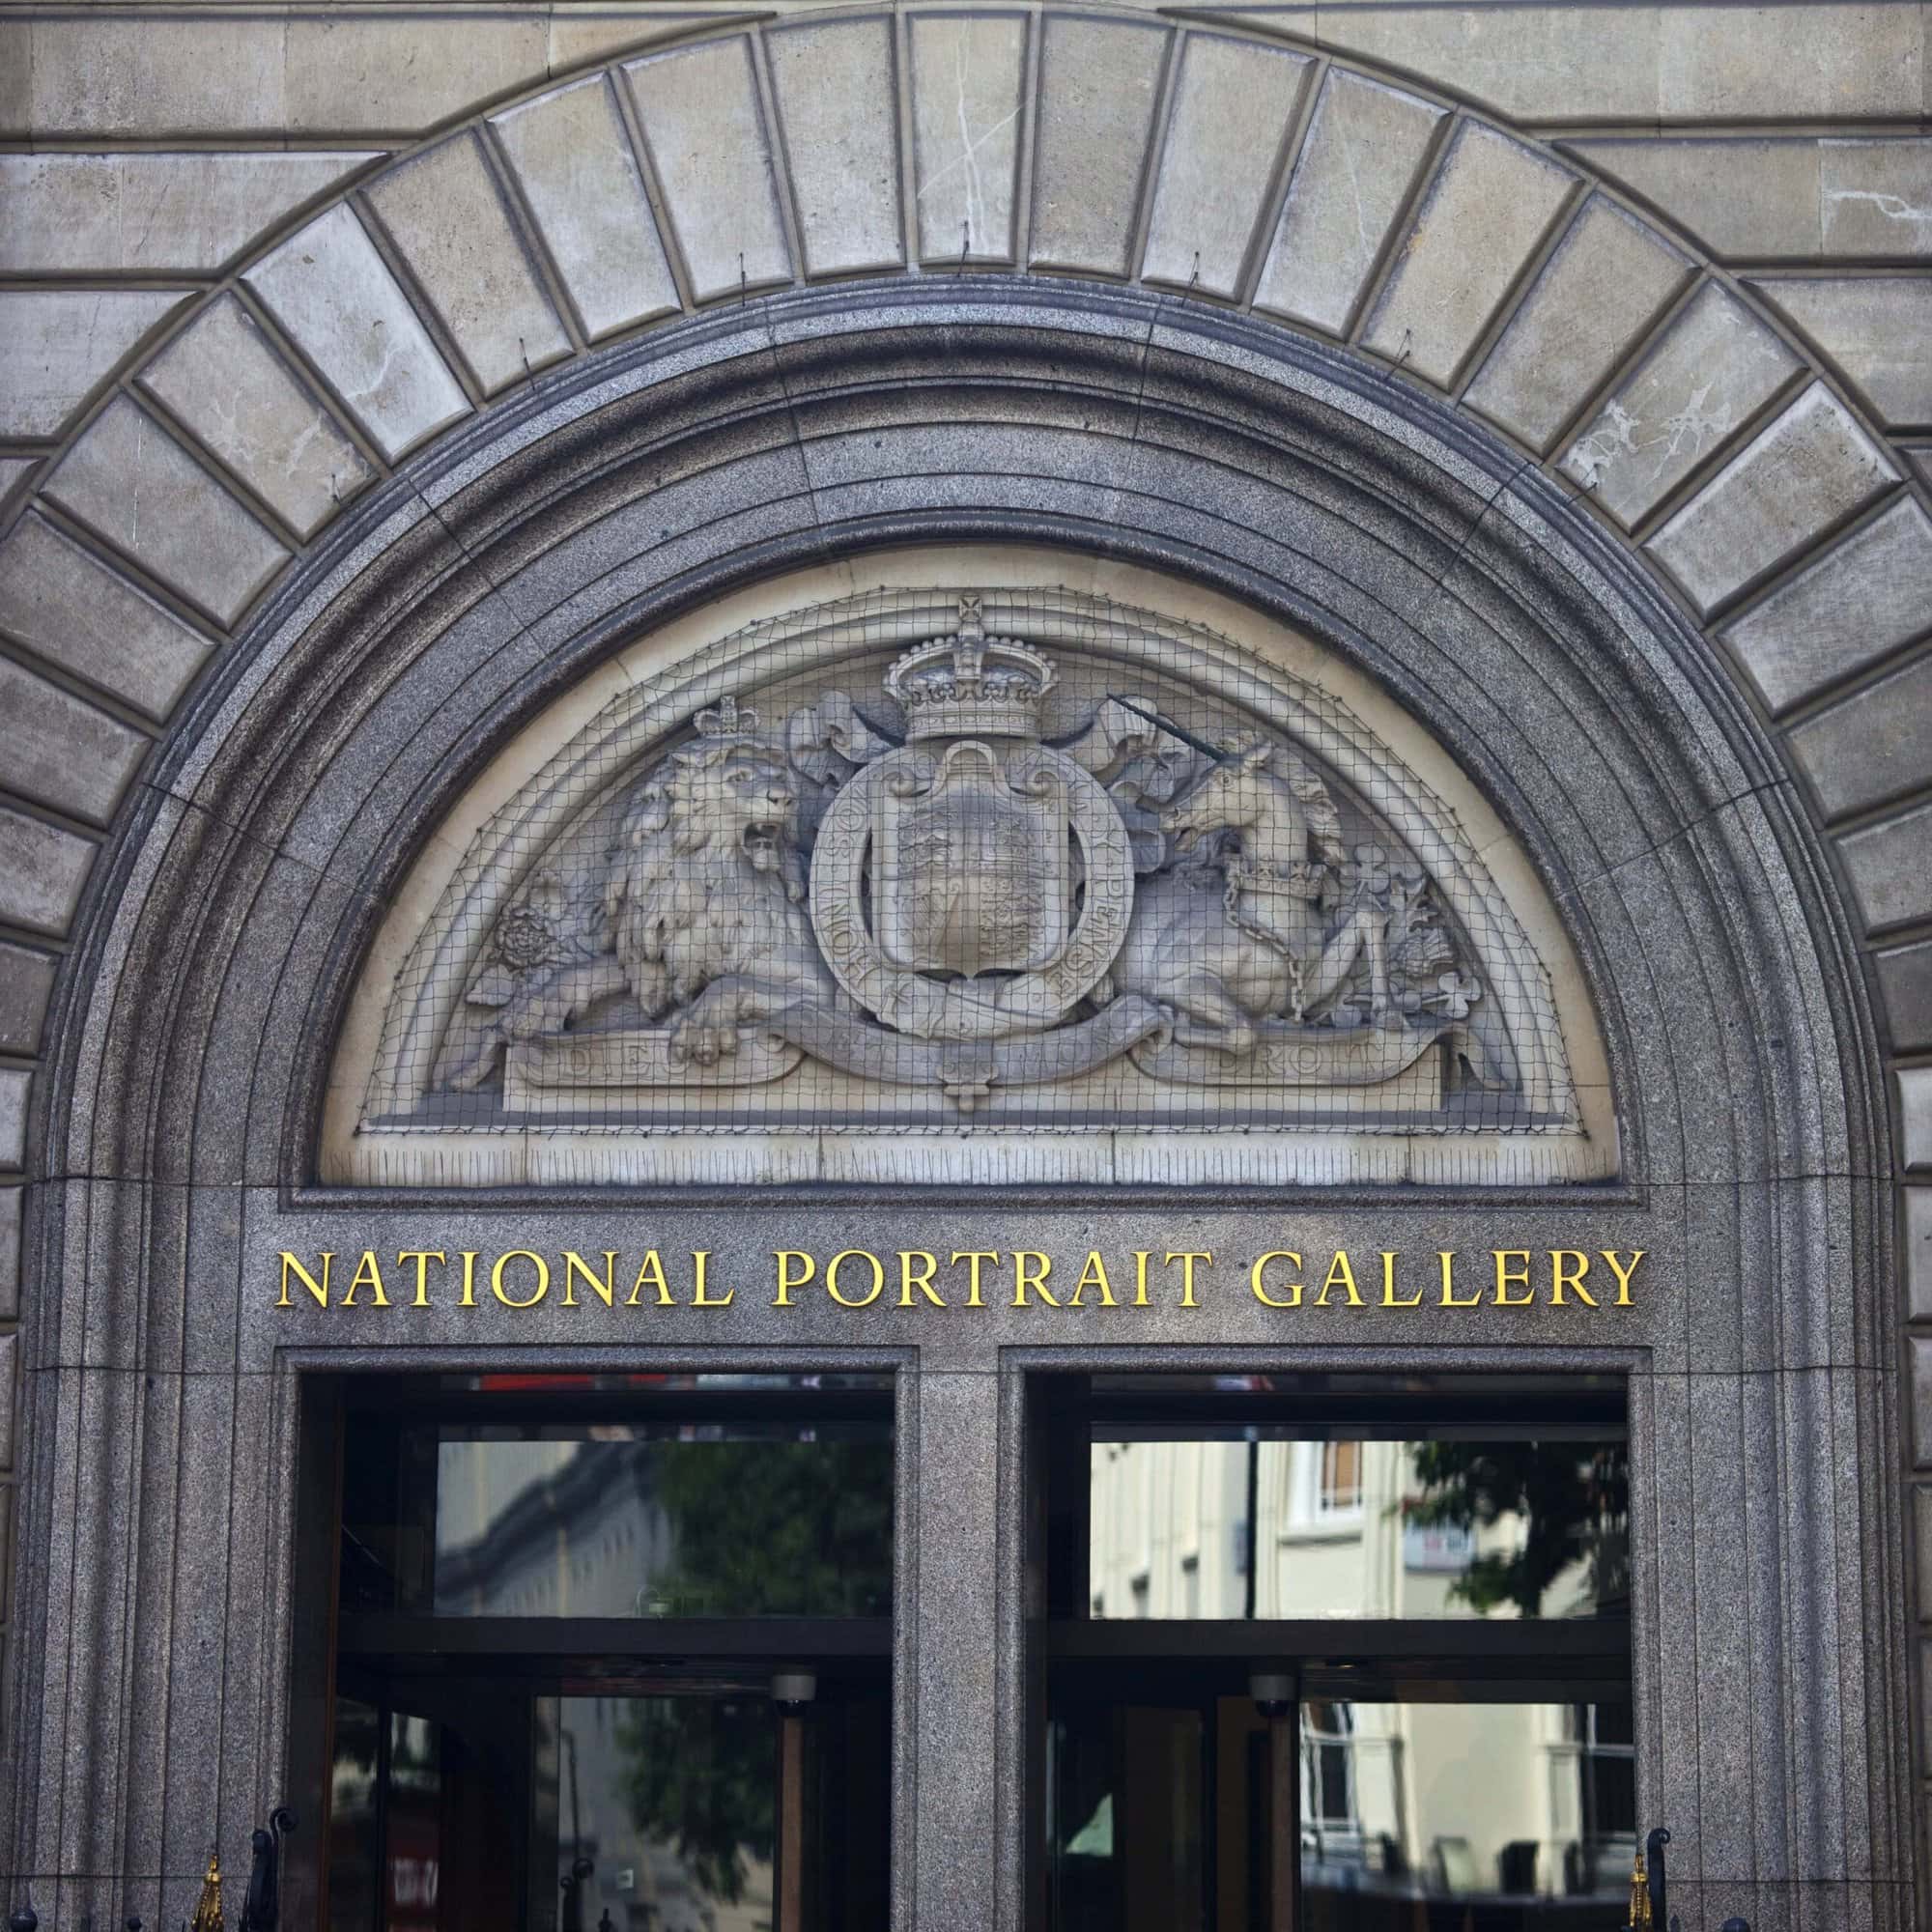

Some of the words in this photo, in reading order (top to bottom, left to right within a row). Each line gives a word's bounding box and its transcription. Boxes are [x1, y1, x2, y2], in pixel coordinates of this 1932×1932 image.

[274, 1250, 736, 1308] NATIONAL
[769, 1249, 1213, 1307] PORTRAIT
[1250, 1249, 1645, 1307] GALLERY
